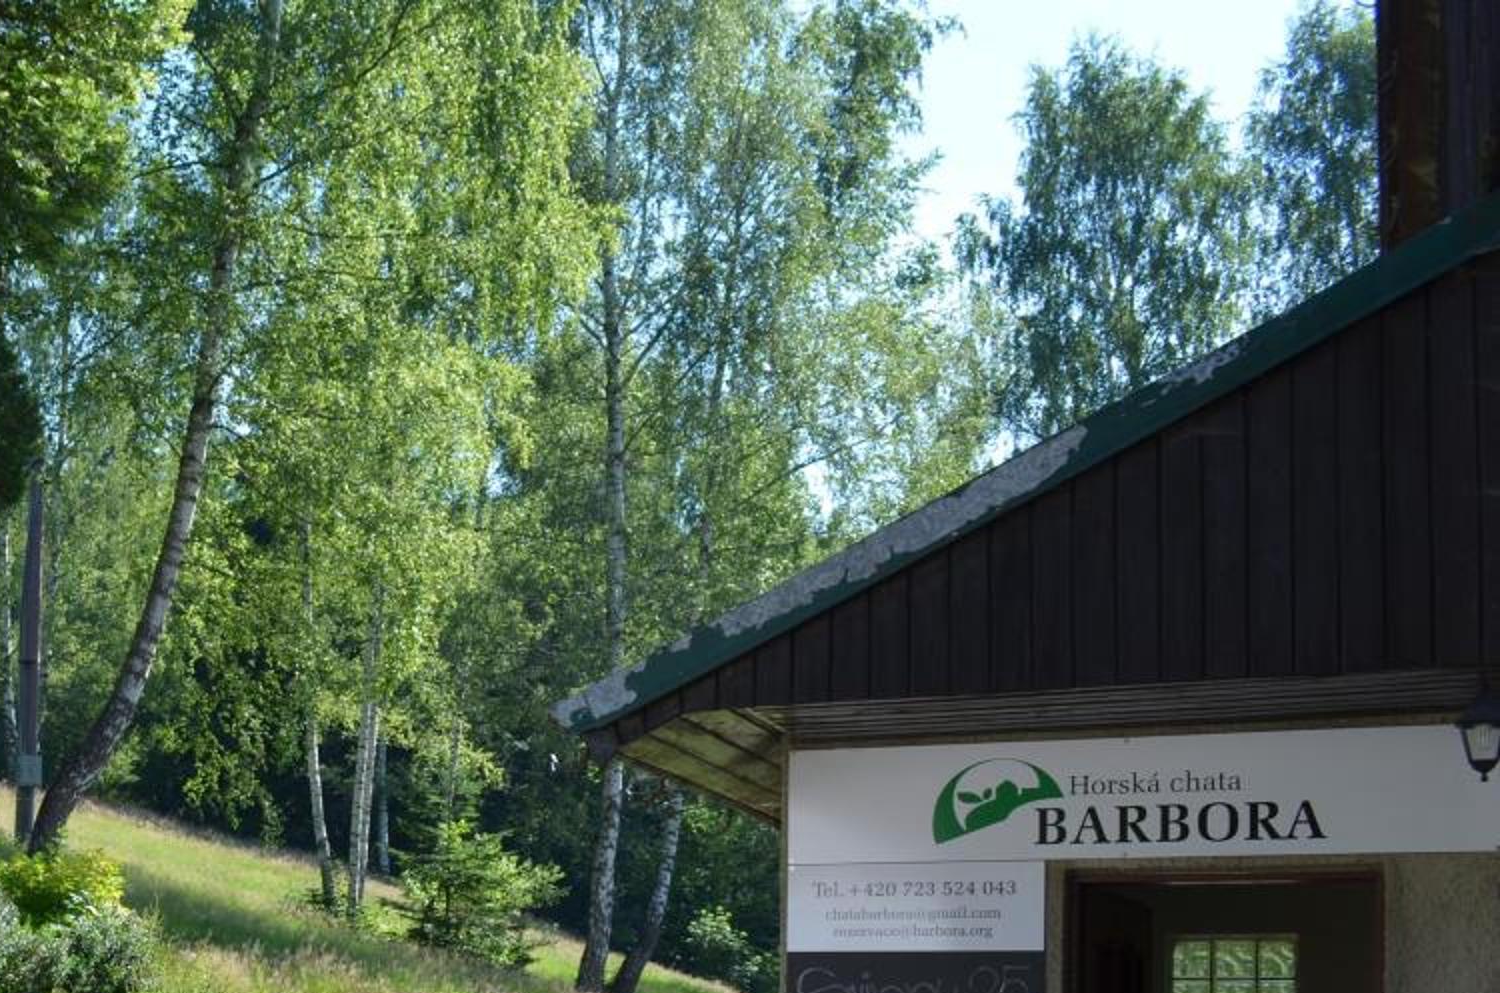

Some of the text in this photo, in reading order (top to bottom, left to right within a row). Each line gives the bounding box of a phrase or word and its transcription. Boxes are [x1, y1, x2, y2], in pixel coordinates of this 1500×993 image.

[1070, 769, 1242, 796] Horská chata
[1034, 799, 1328, 846] BARBORA
[812, 880, 1018, 898] Tel. +420 723 524 043
